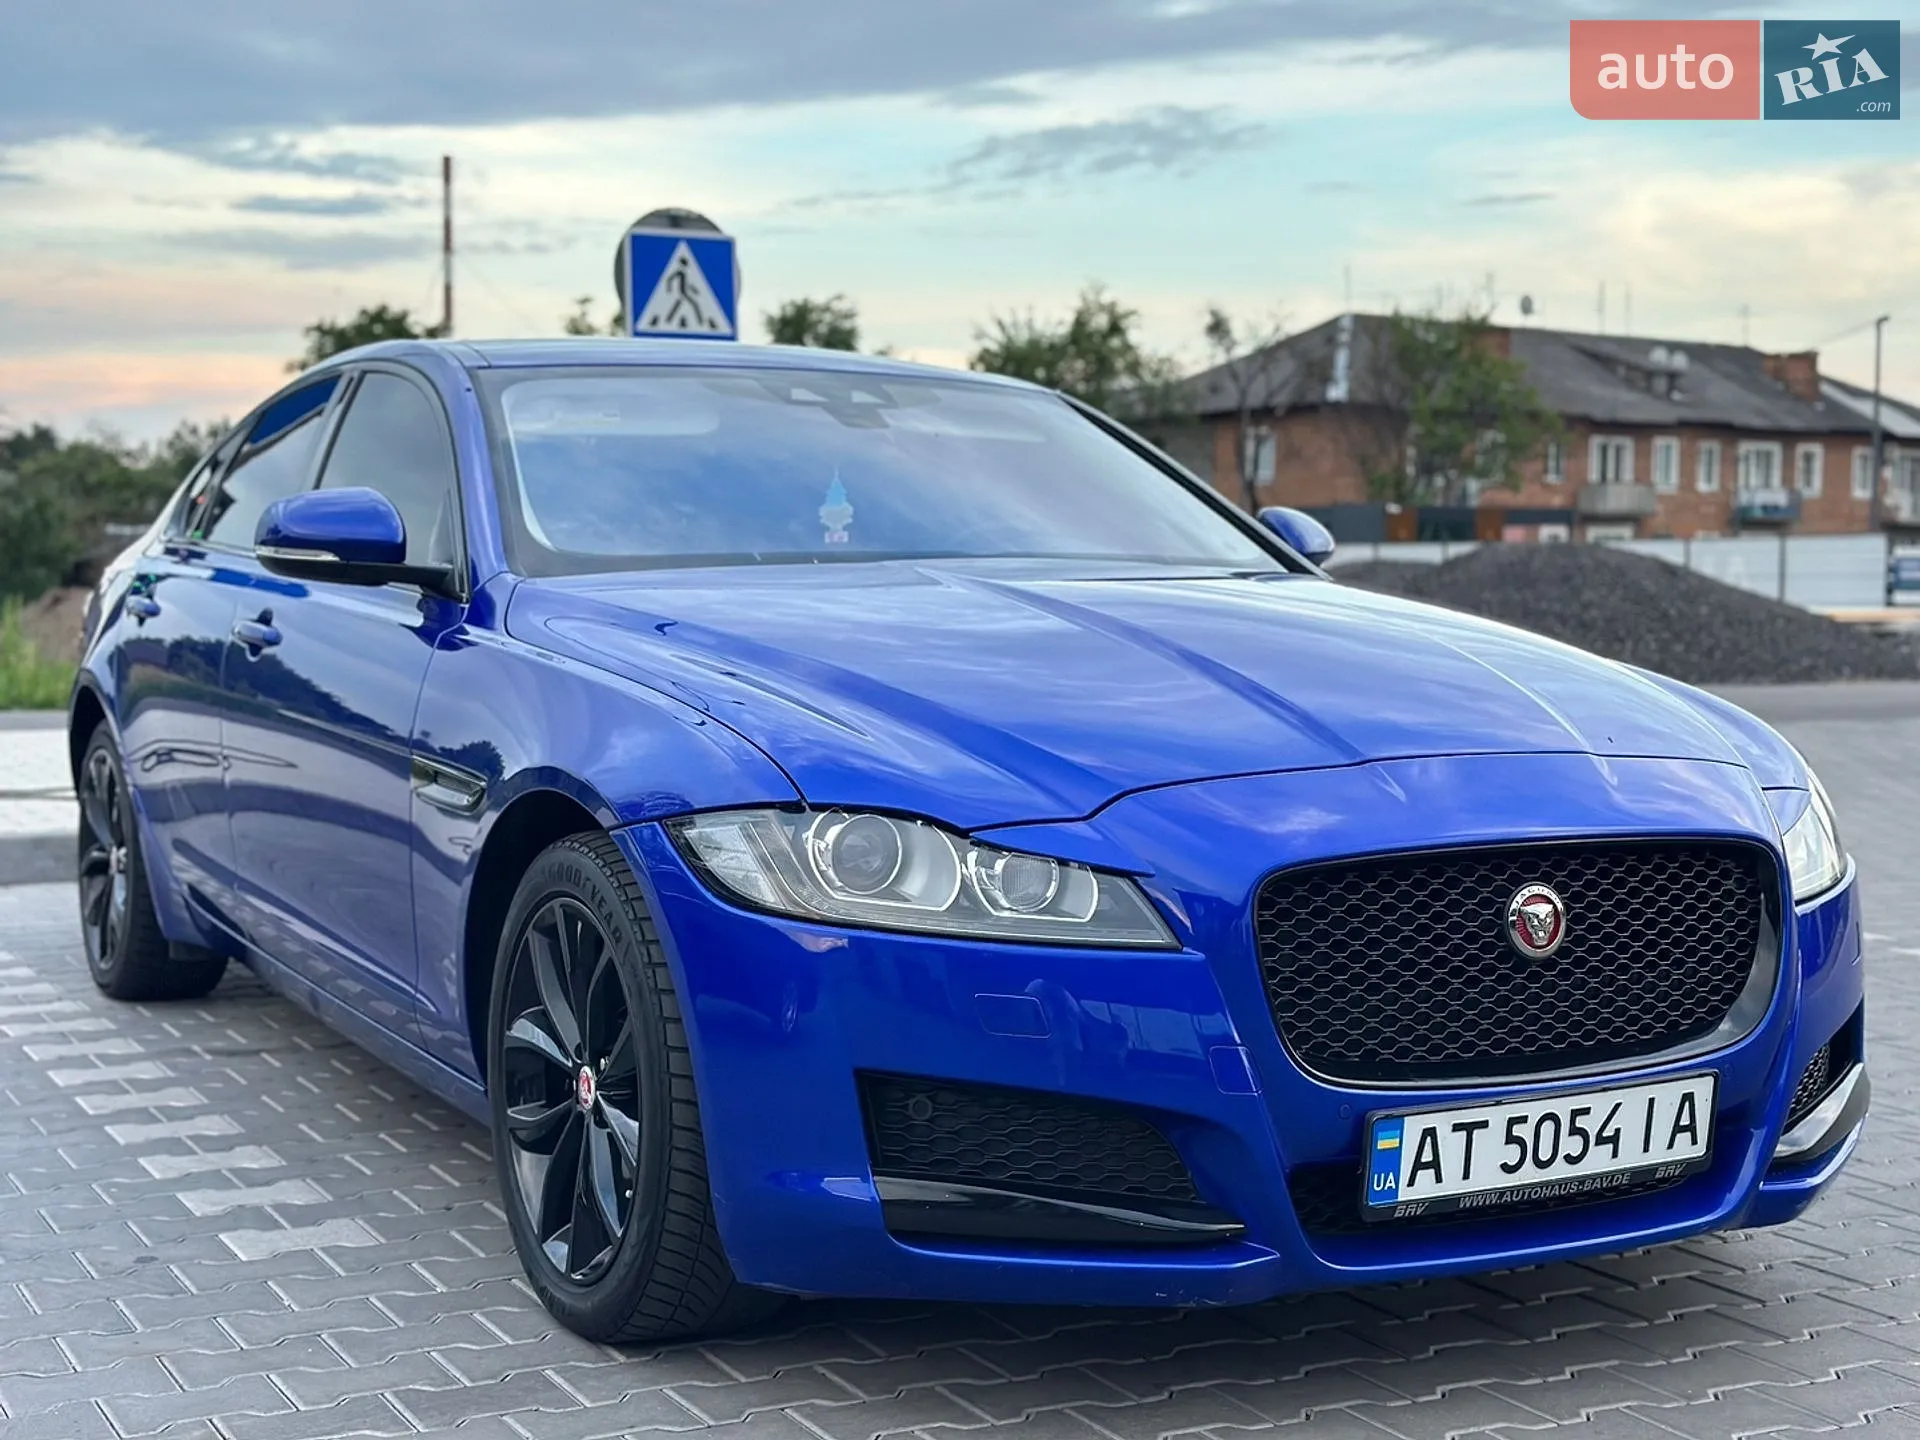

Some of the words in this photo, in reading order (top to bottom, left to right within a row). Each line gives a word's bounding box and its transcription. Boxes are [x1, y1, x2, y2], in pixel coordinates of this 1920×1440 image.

[1406, 1119, 1490, 1188] AT
[1499, 1101, 1623, 1175] 5054
[1642, 1091, 1699, 1154] IA
[1373, 1171, 1396, 1191] UA
[1458, 1173, 1632, 1209] WWW.AUTOHAUS-BAV.DE
